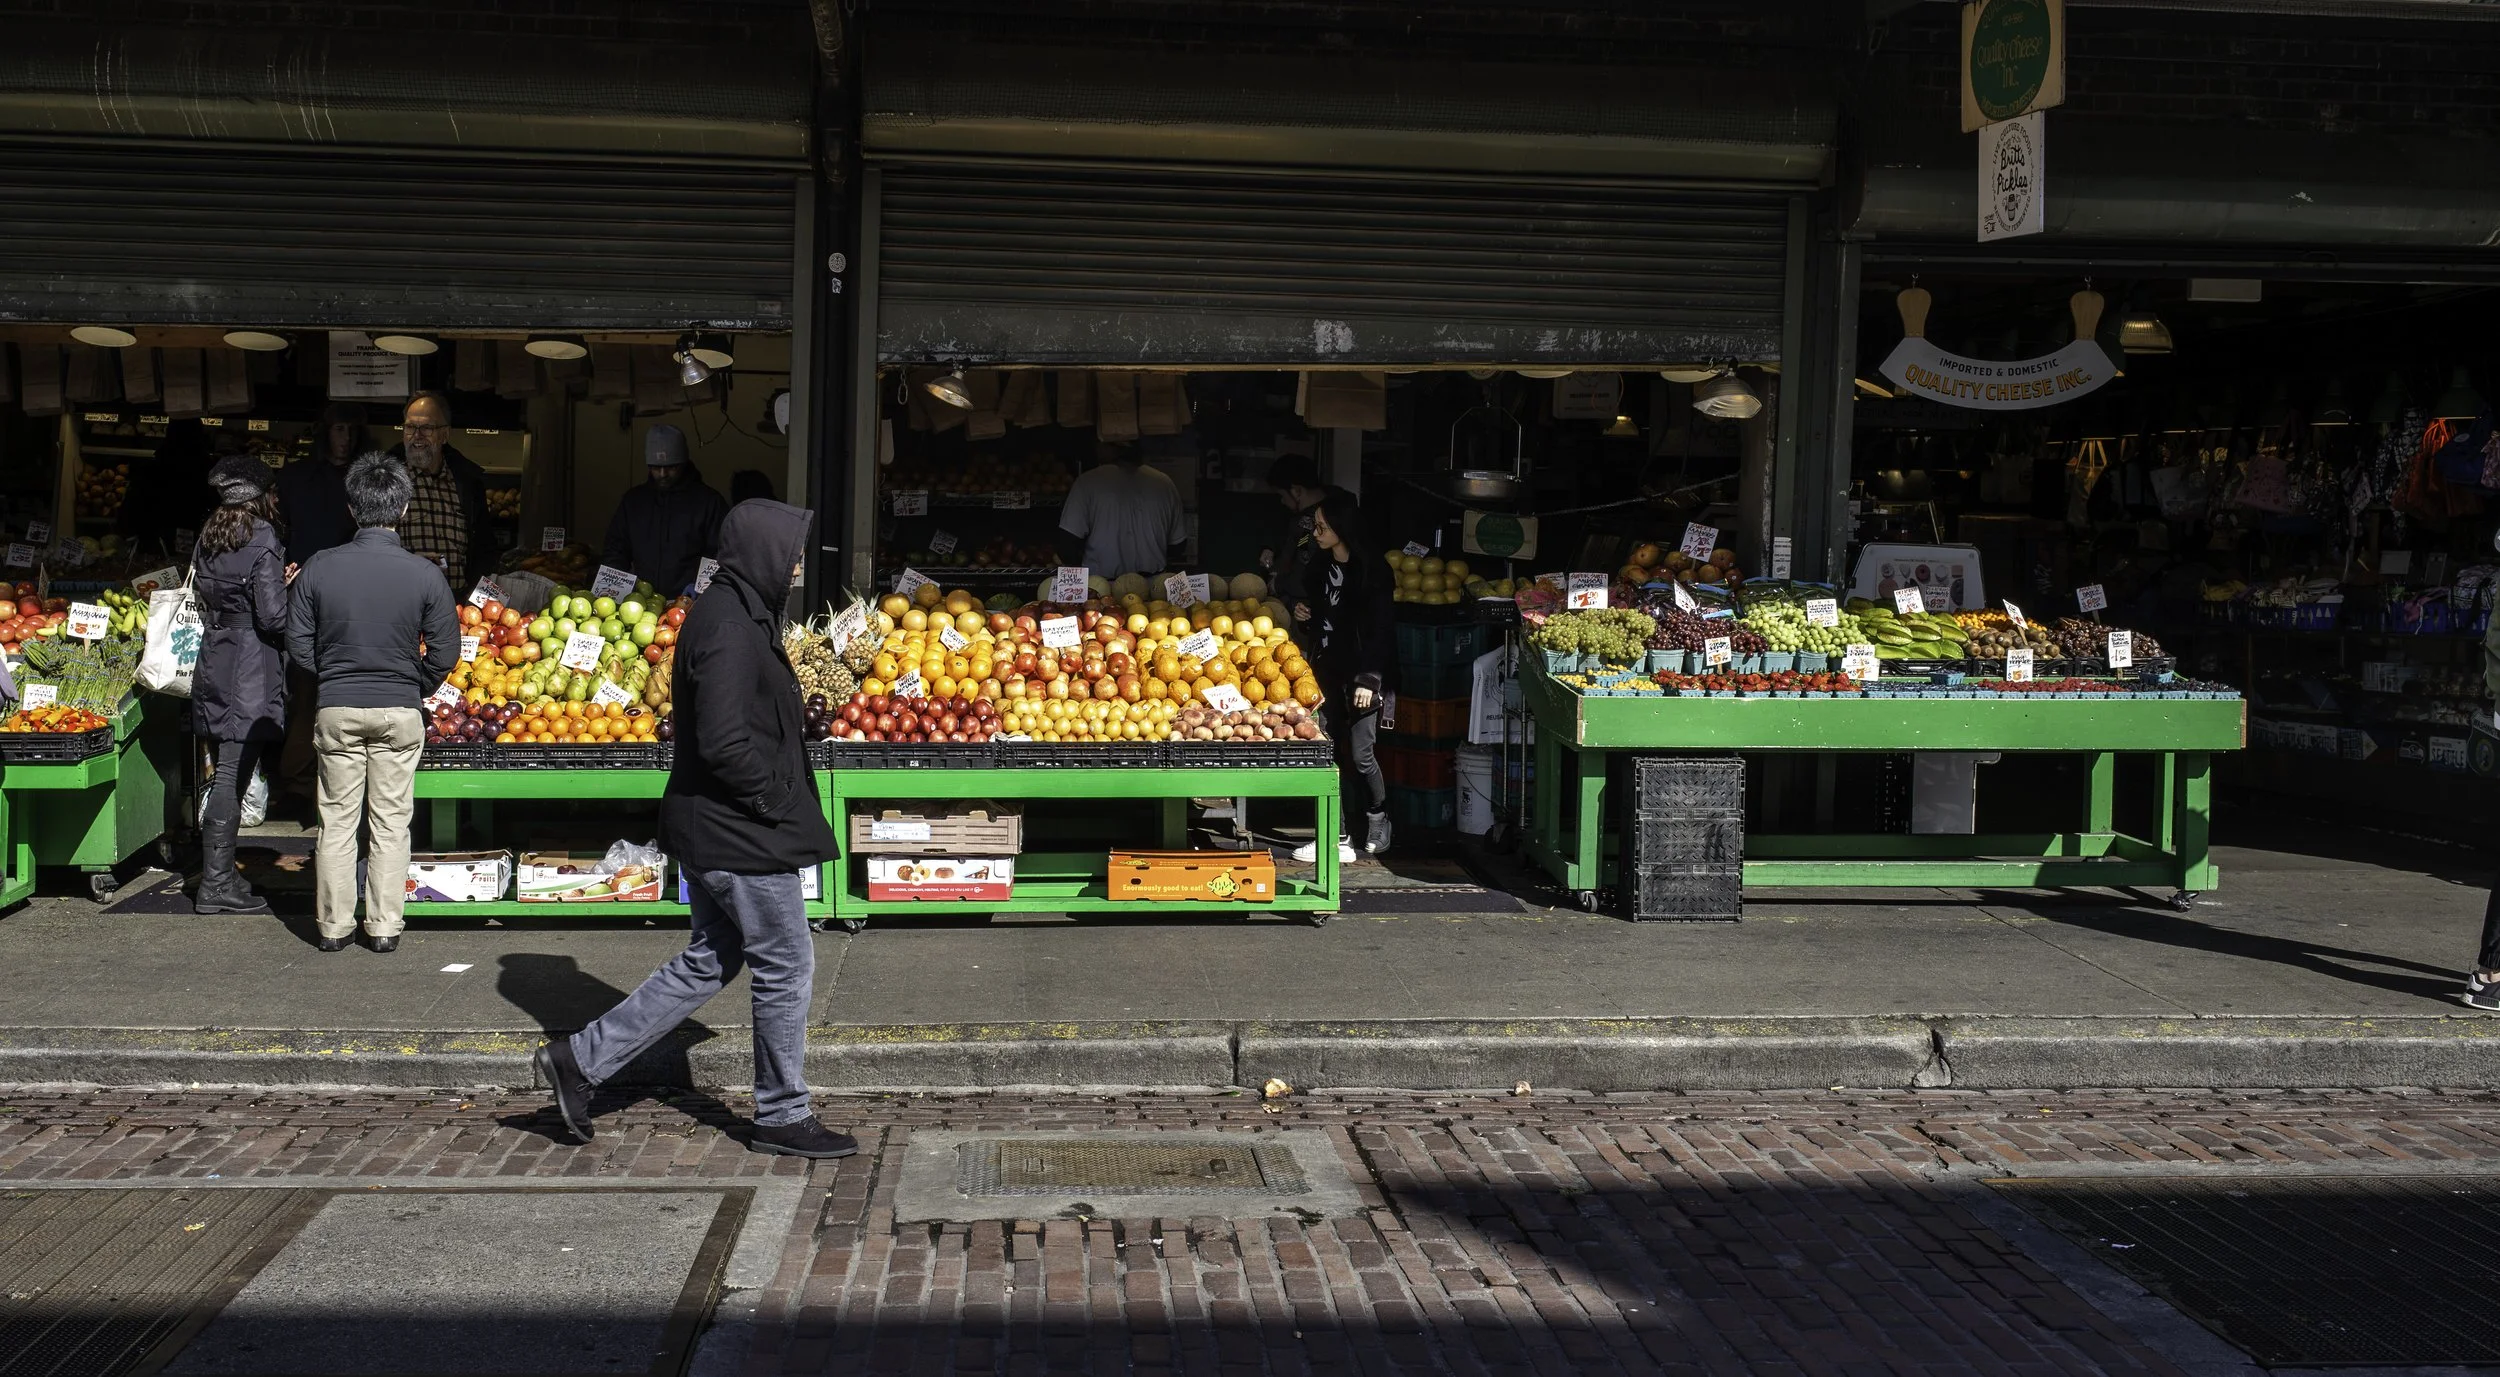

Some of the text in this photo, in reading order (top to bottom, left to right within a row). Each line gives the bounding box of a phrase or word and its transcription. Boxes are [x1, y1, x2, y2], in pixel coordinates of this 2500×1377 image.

[1977, 38, 2008, 68] Quality
[2000, 122, 2020, 142] CULTURE
[2019, 125, 2033, 156] FOODS
[1996, 166, 2028, 195] Pickles
[1939, 358, 2059, 377] IMPORTED & DOMESTIC
[1905, 363, 2092, 401] QUALITY CHEESE INC.
[176, 613, 206, 625] Quality
[175, 669, 187, 677] Pike
[2432, 747, 2465, 769] SEATTLE
[1122, 884, 1204, 893] Enormously good to eat!
